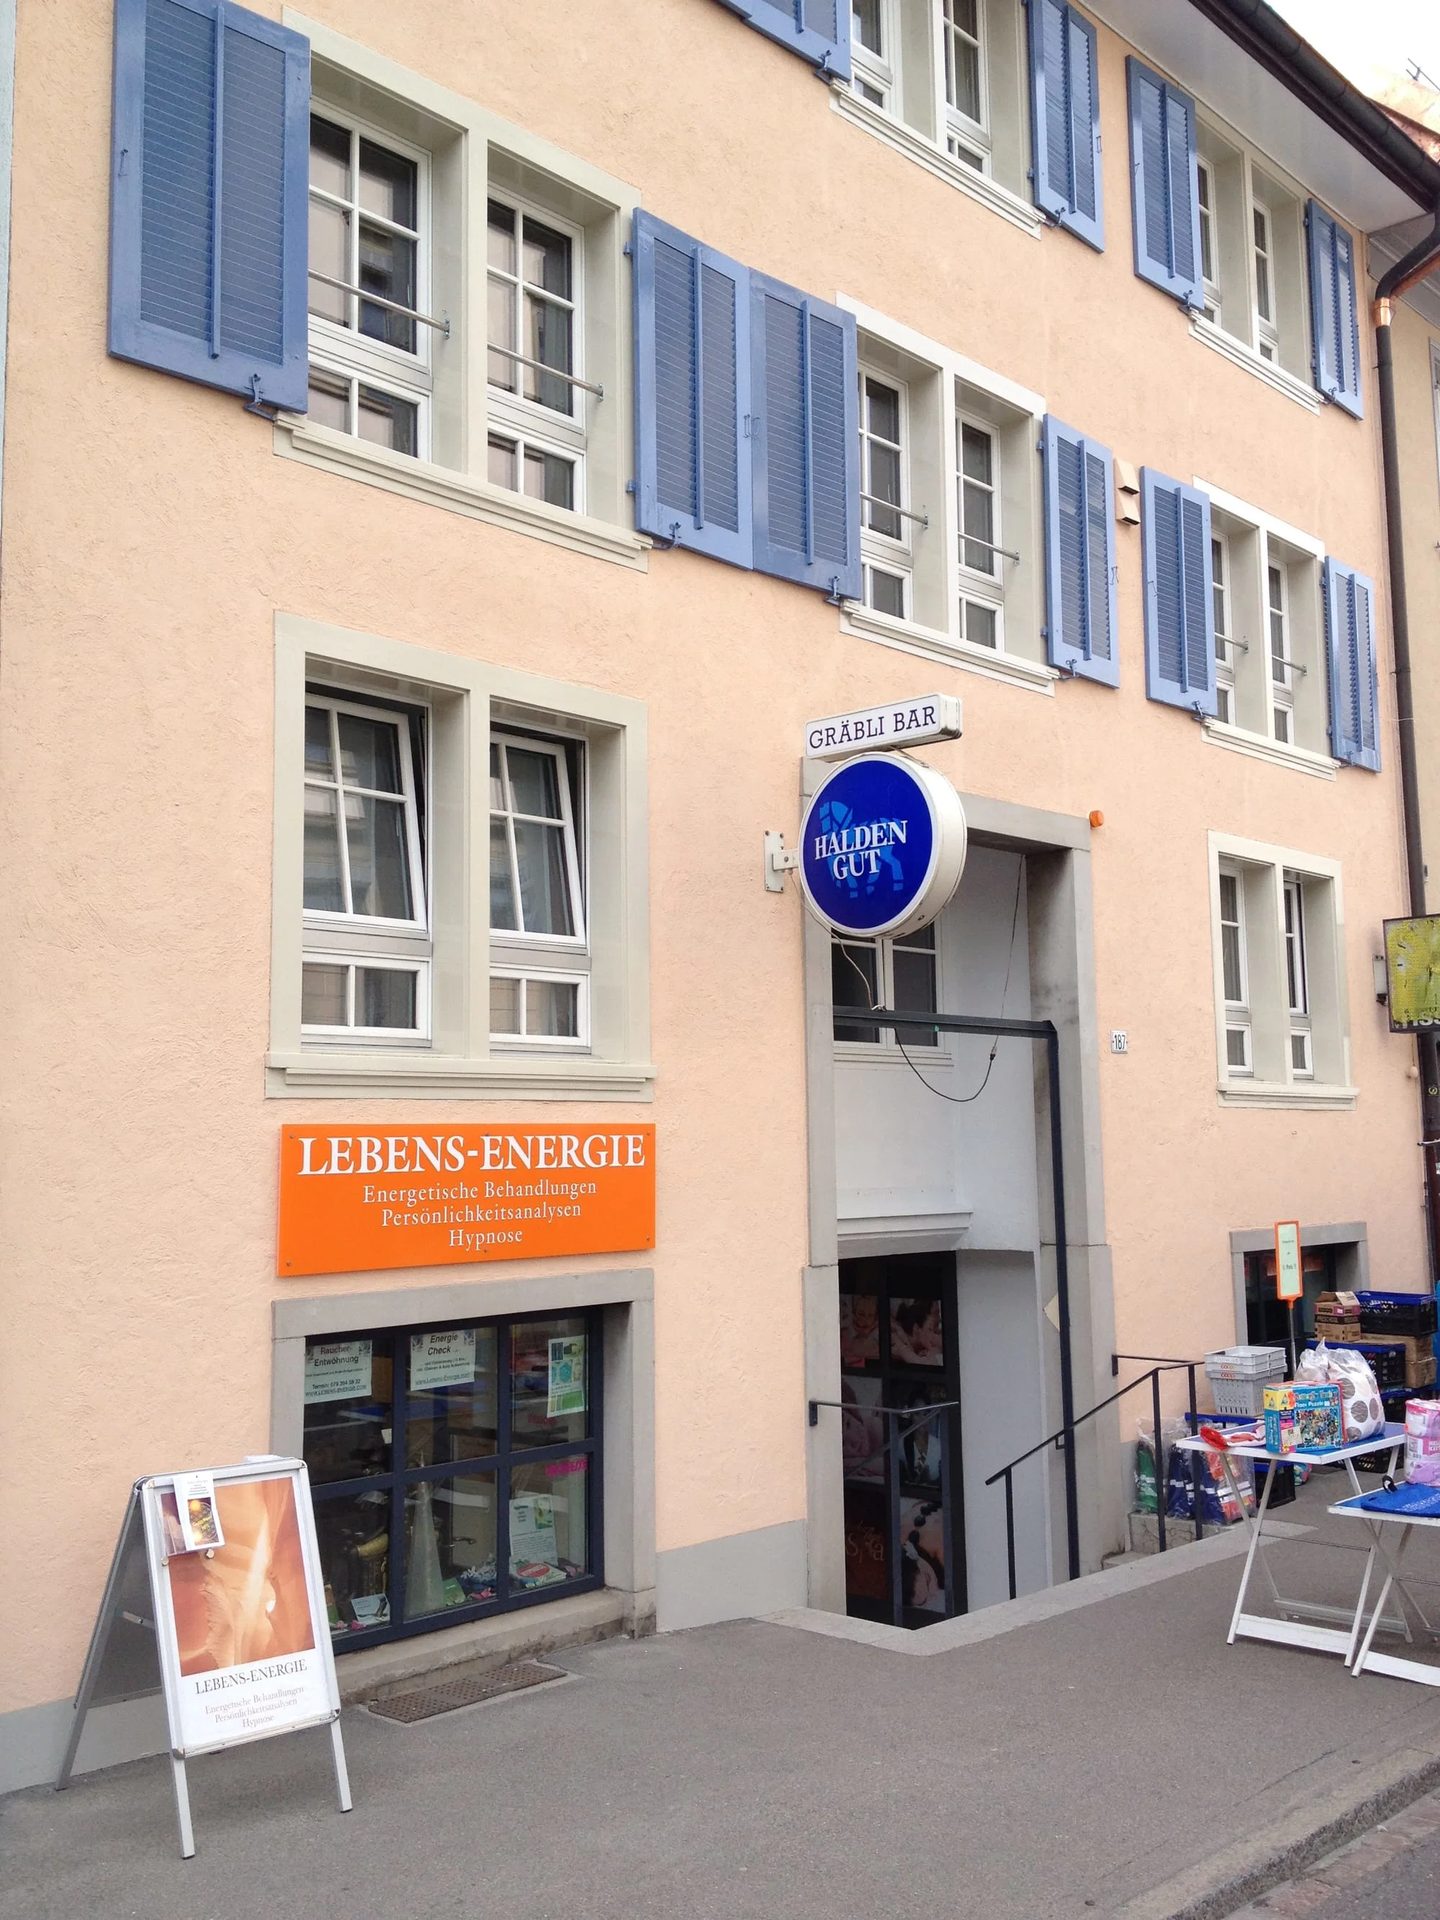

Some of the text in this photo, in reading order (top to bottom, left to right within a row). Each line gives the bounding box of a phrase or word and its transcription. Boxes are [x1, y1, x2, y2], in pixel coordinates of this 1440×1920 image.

[809, 705, 936, 749] GRÄBLI BAR
[814, 819, 908, 860] HALDEN
[832, 849, 881, 880] GUT
[1114, 1034, 1126, 1050] 187
[297, 1134, 645, 1176] LEBENS-ENERGIE
[362, 1179, 597, 1208] Energetische Behandlungen
[381, 1202, 581, 1227] Persönlichkeitsanalysen
[449, 1227, 523, 1253] Hypnose
[195, 1659, 308, 1695] LEBENS-ENERGIE
